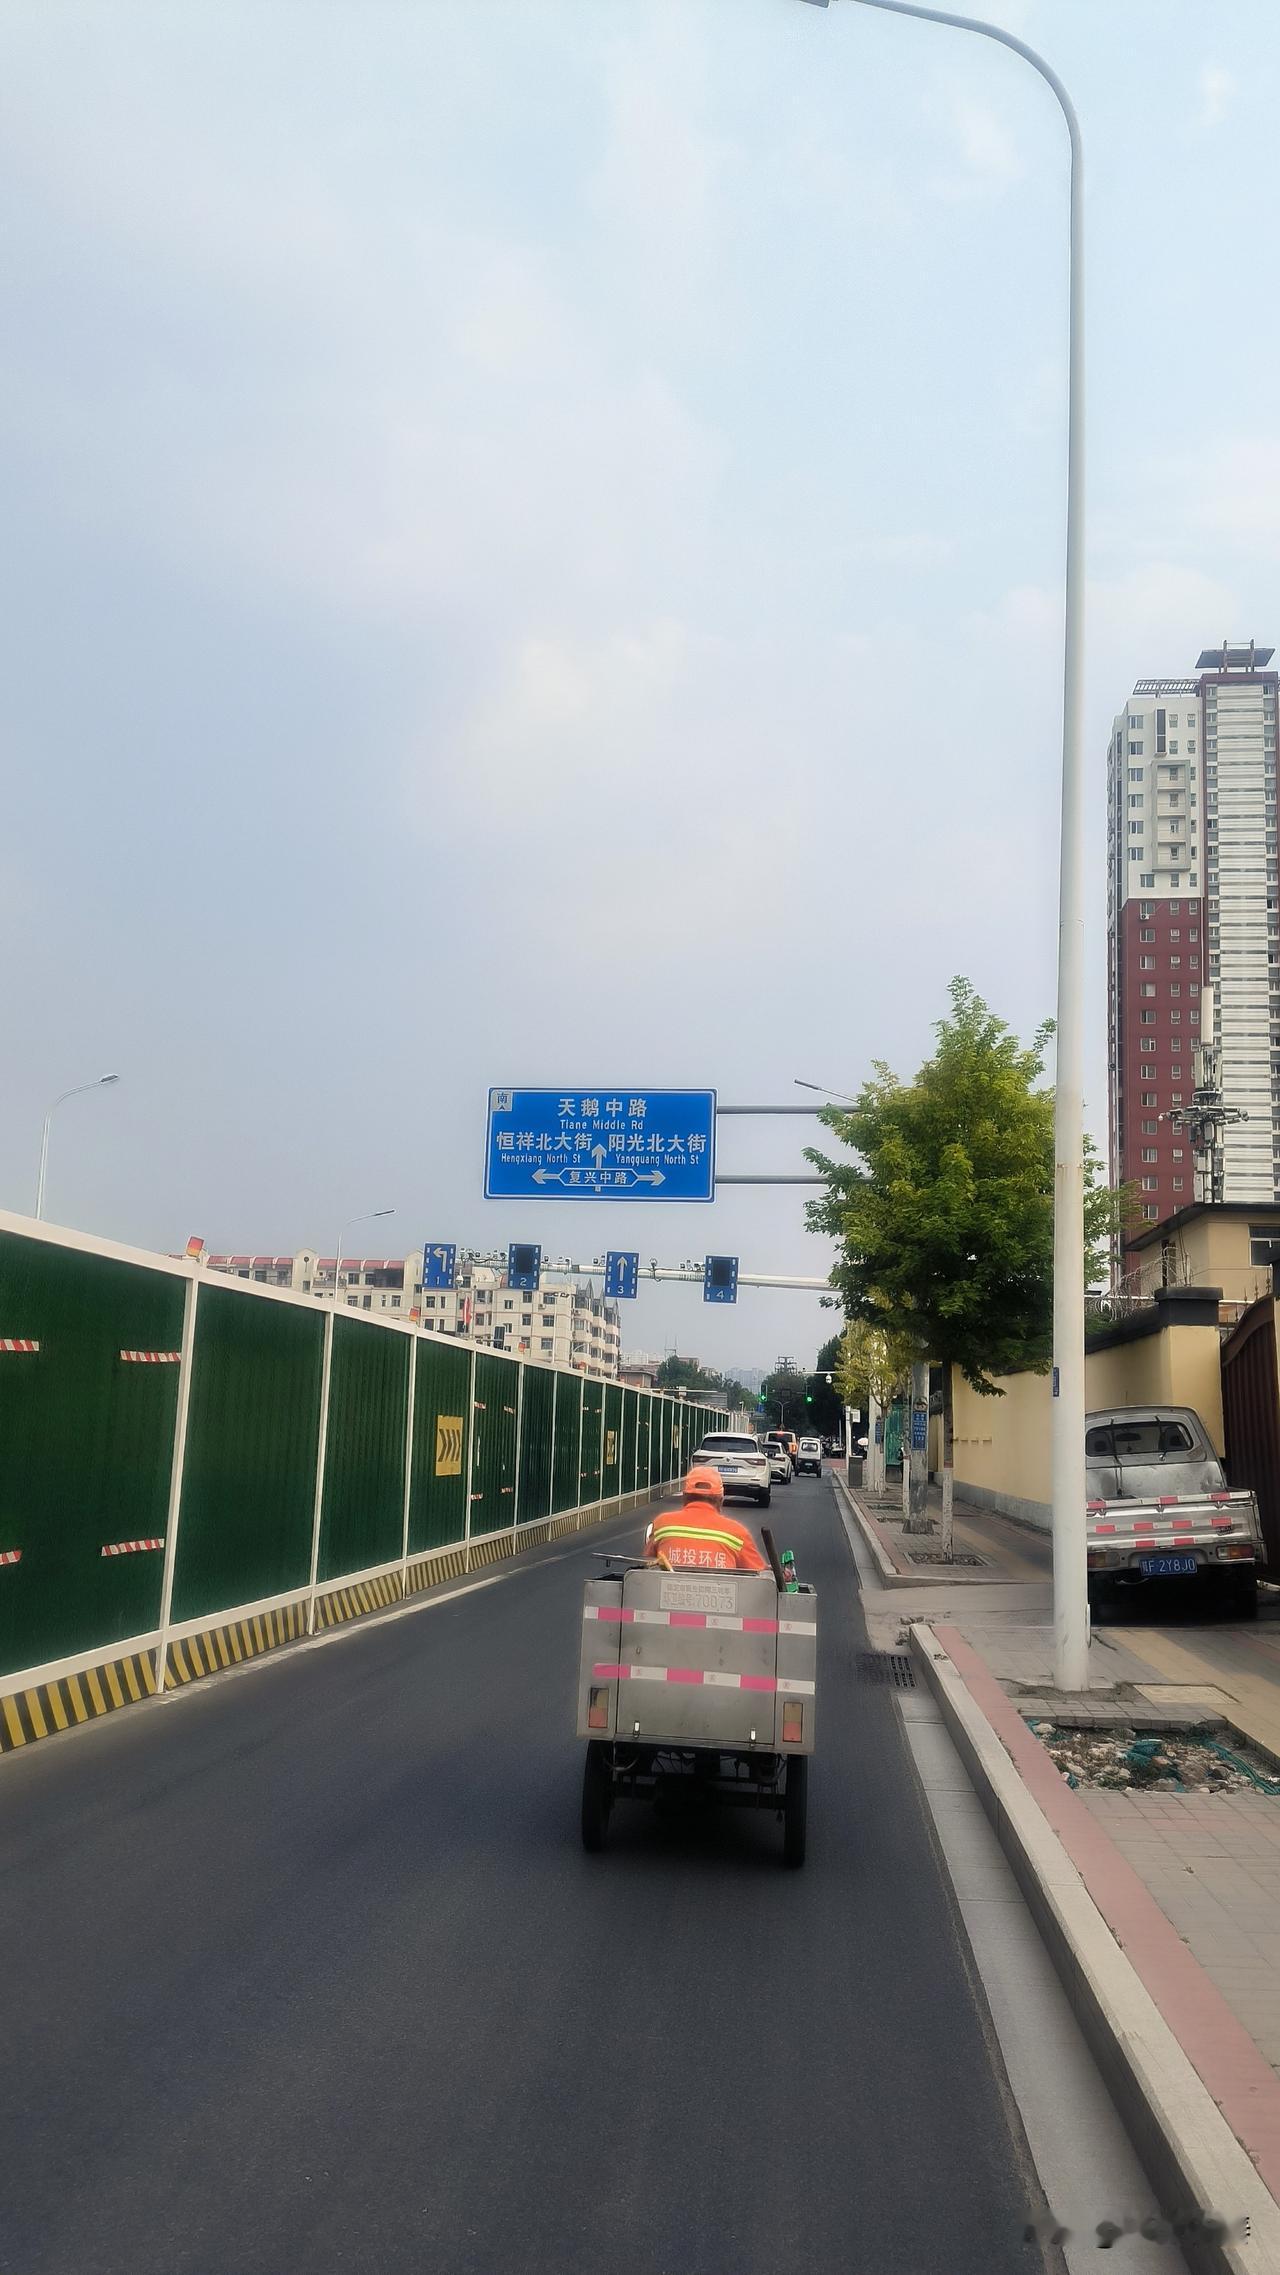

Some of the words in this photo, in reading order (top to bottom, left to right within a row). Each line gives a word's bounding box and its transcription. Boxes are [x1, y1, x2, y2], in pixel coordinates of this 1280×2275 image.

[497, 1091, 510, 1104] 南
[557, 1097, 648, 1118] 天鹅中路
[560, 1119, 587, 1130] Tiane
[593, 1119, 626, 1130] Middle
[631, 1120, 644, 1130] Rd
[496, 1131, 593, 1152] 恒祥北大街
[608, 1133, 707, 1153] 阳光北大街
[501, 1152, 542, 1166] Hengxiang
[546, 1153, 568, 1164] North
[572, 1153, 581, 1164] St
[616, 1153, 660, 1167] Yangguang
[664, 1154, 686, 1165] North
[690, 1154, 699, 1165] St
[569, 1171, 628, 1185] 复兴中路
[520, 1277, 527, 1286] 2
[617, 1285, 624, 1294] 3
[716, 1290, 725, 1300] 4
[669, 1547, 727, 1568] 城投环保
